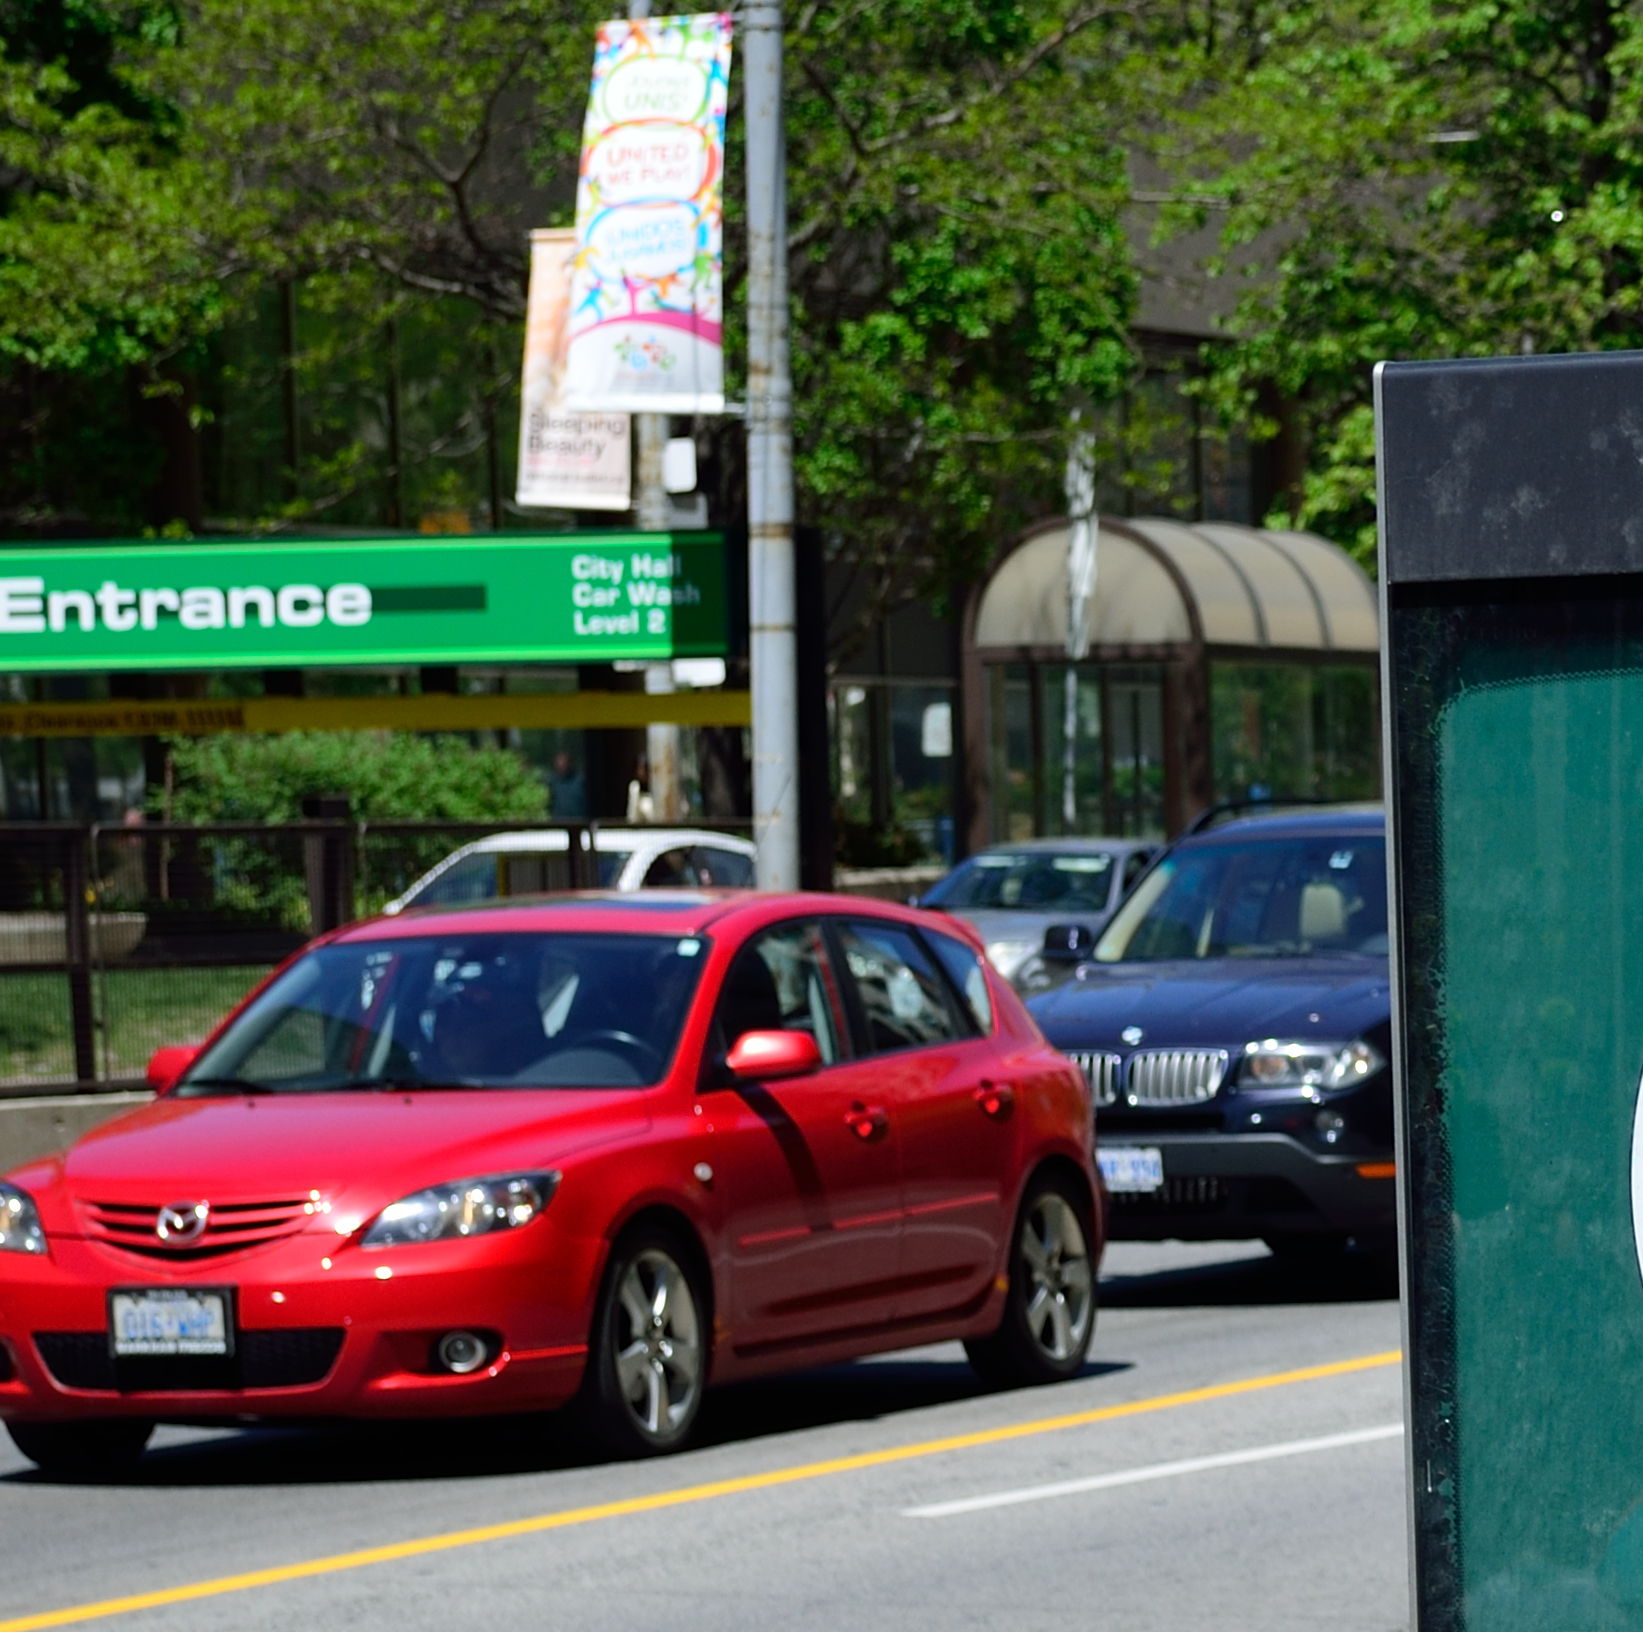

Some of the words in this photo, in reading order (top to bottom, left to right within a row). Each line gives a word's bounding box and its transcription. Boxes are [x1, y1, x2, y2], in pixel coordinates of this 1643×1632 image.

[606, 144, 690, 166] UNITED
[607, 168, 632, 184] WE
[529, 411, 625, 439] Sleeping
[529, 434, 607, 462] Beauty
[571, 553, 624, 585] City
[631, 552, 682, 579] Hall
[0, 576, 373, 633] Entrance
[572, 581, 621, 607] Car
[626, 580, 700, 607] Wash
[573, 608, 639, 635] Level
[647, 608, 666, 634] 2
